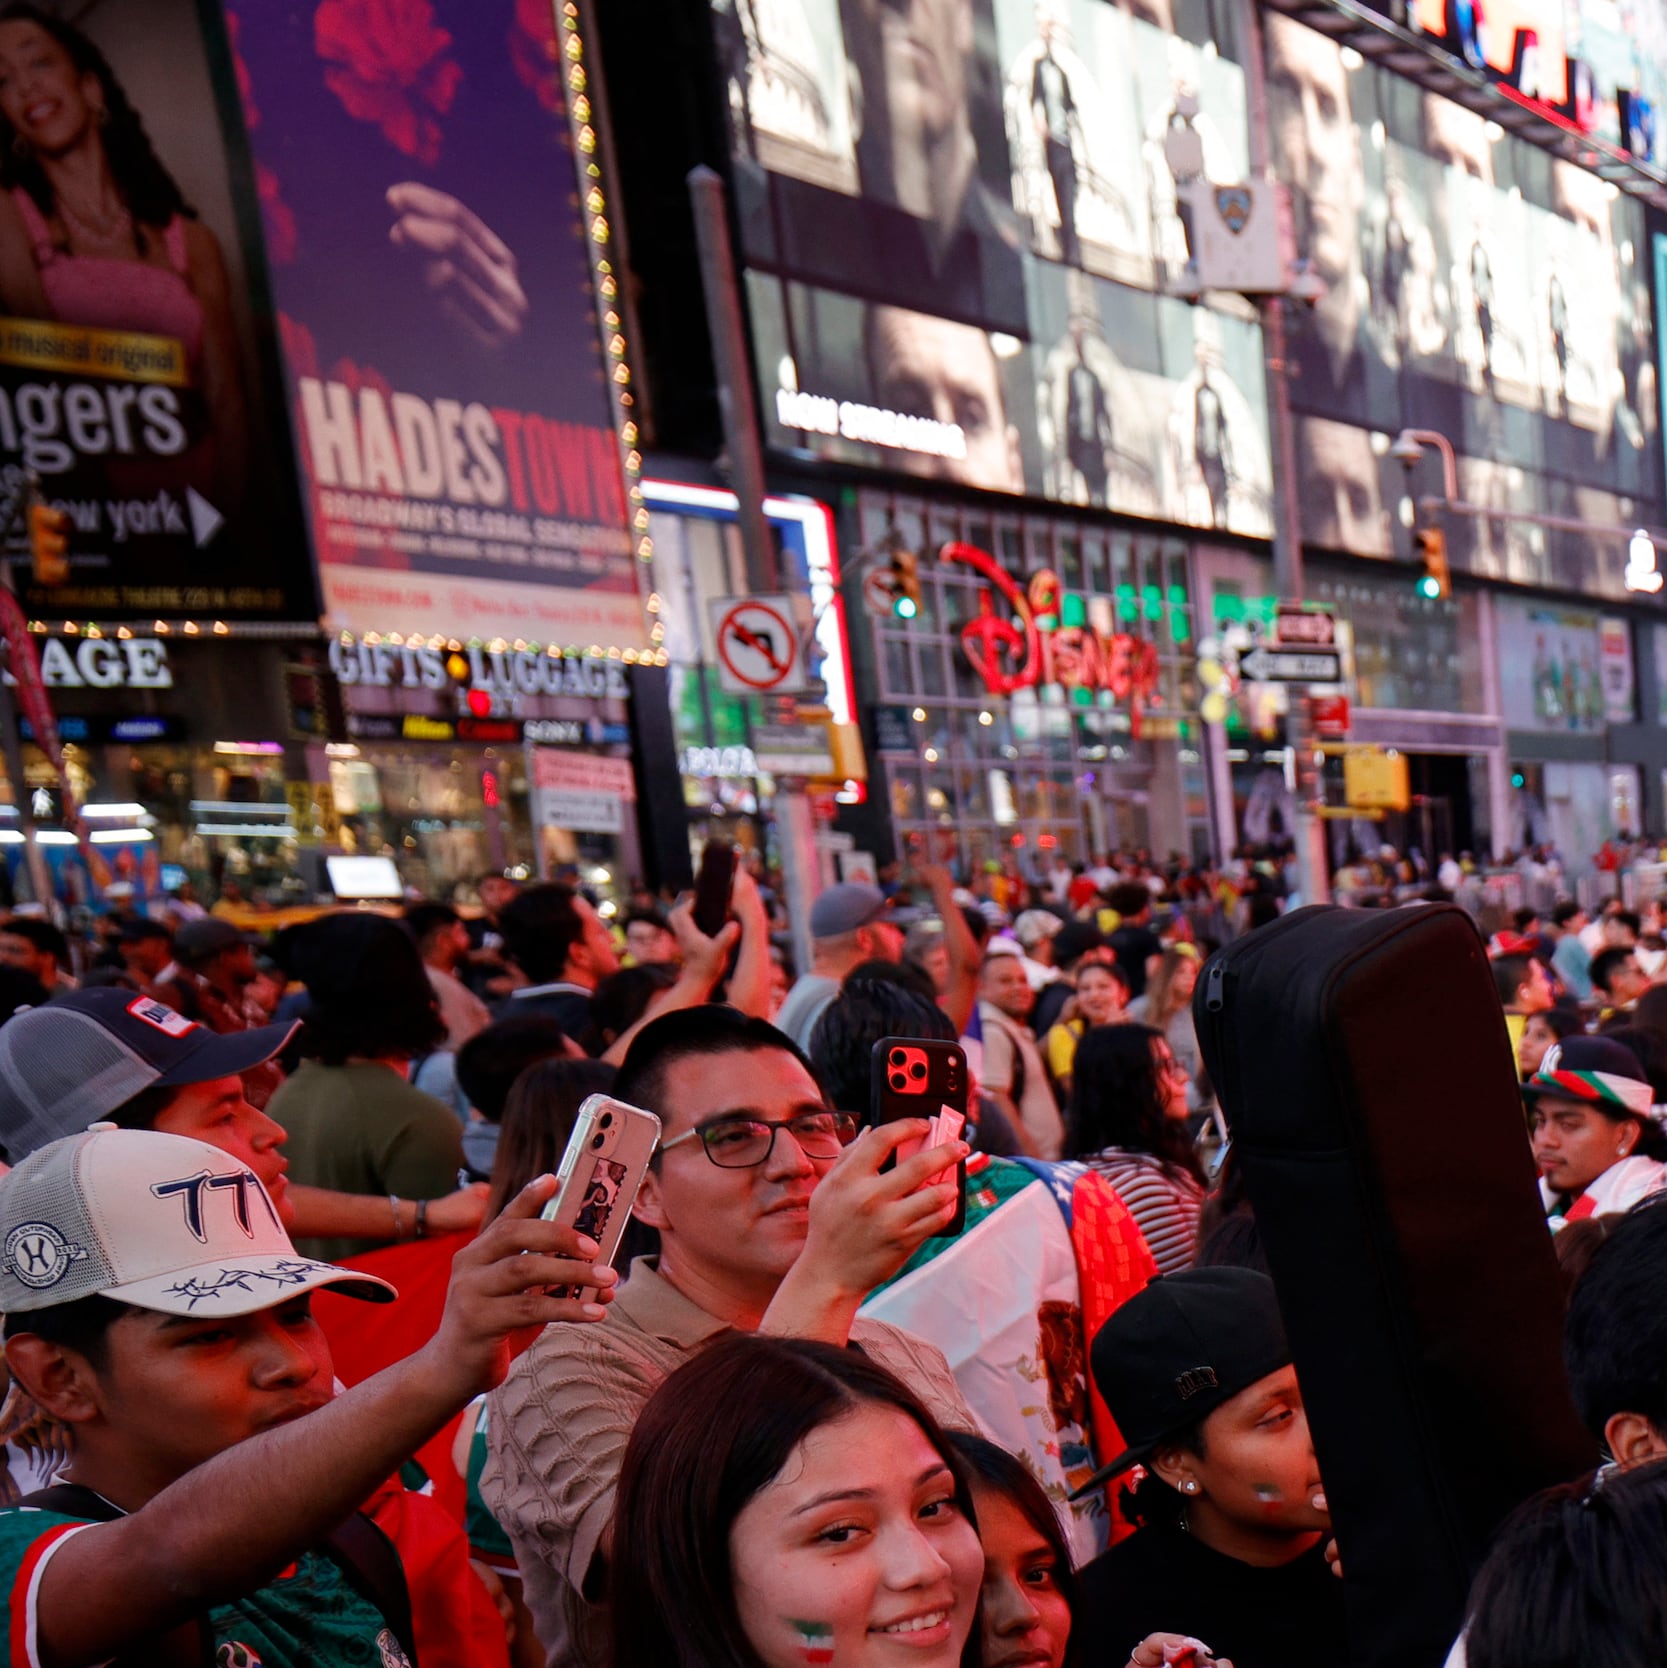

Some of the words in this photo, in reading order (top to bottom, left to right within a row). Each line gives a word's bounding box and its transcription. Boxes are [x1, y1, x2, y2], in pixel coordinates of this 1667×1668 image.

[2, 638, 173, 688] AGE
[329, 638, 447, 690] GIFTS
[467, 643, 630, 698] LUGGAGE
